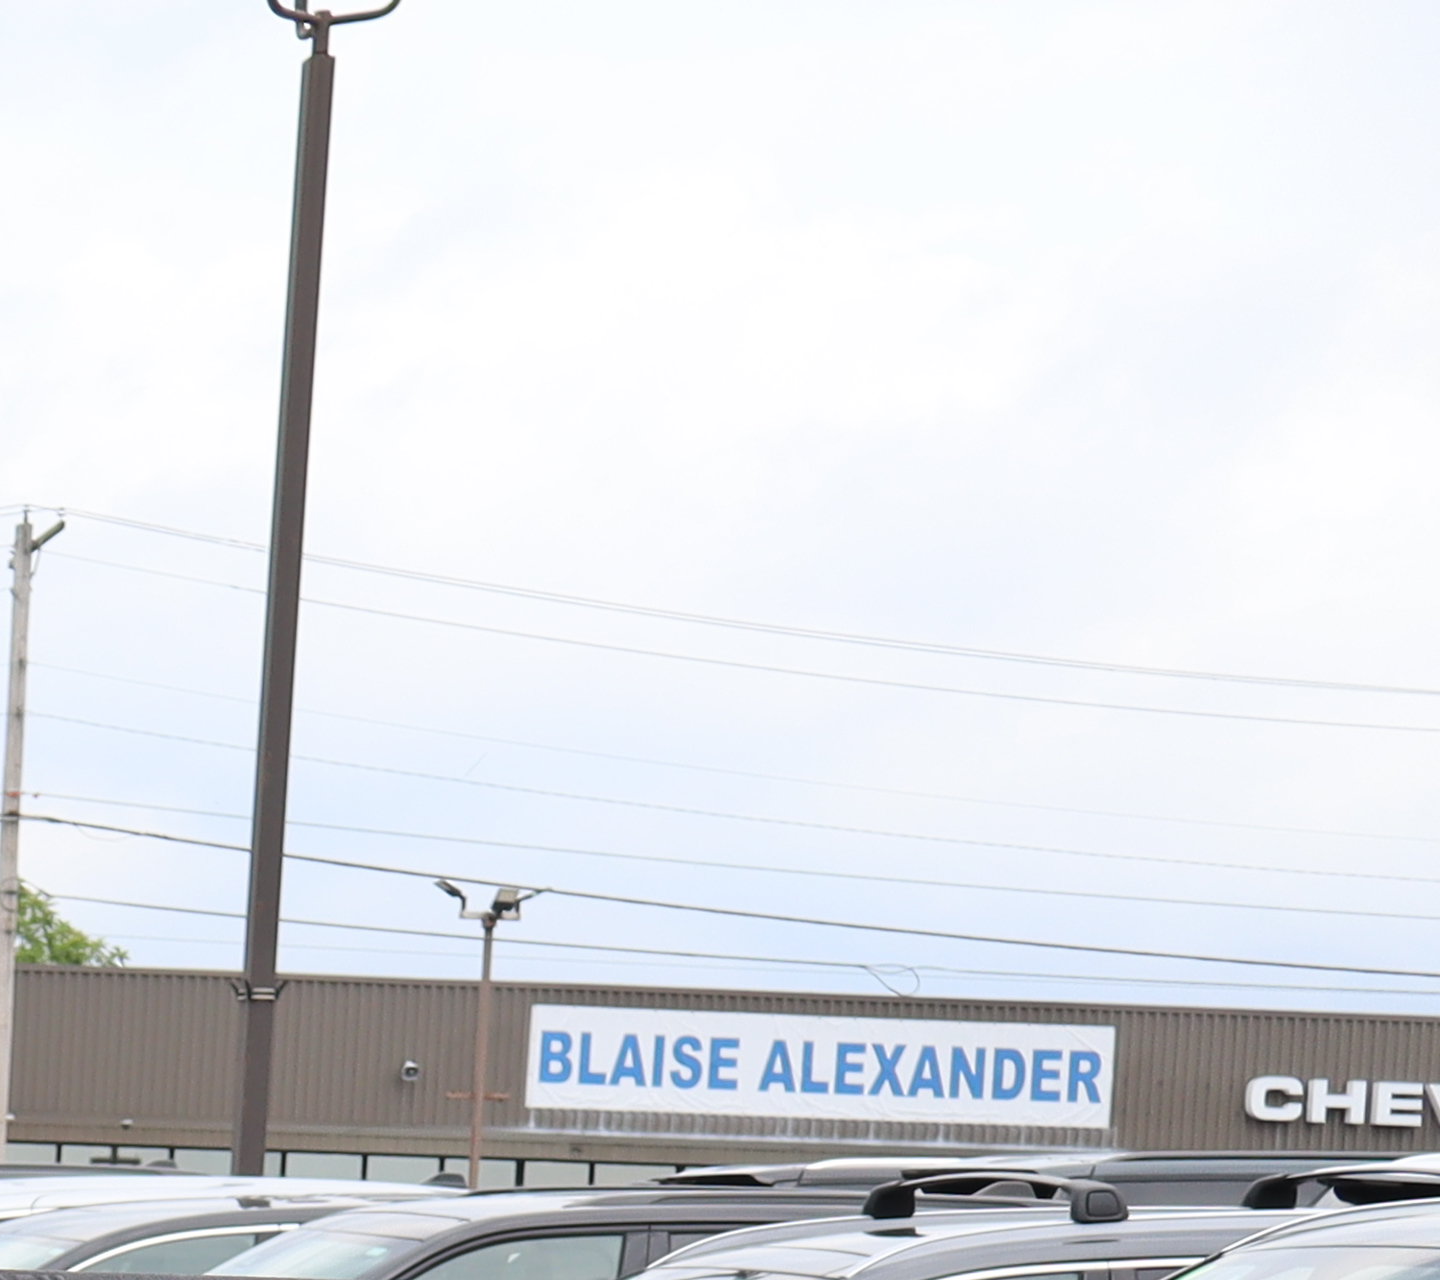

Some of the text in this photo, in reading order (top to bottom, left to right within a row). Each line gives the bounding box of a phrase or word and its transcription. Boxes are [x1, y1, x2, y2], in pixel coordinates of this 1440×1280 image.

[538, 1029, 1103, 1105] BLAISE ALEXANDER
[1244, 1075, 1440, 1128] CHE
